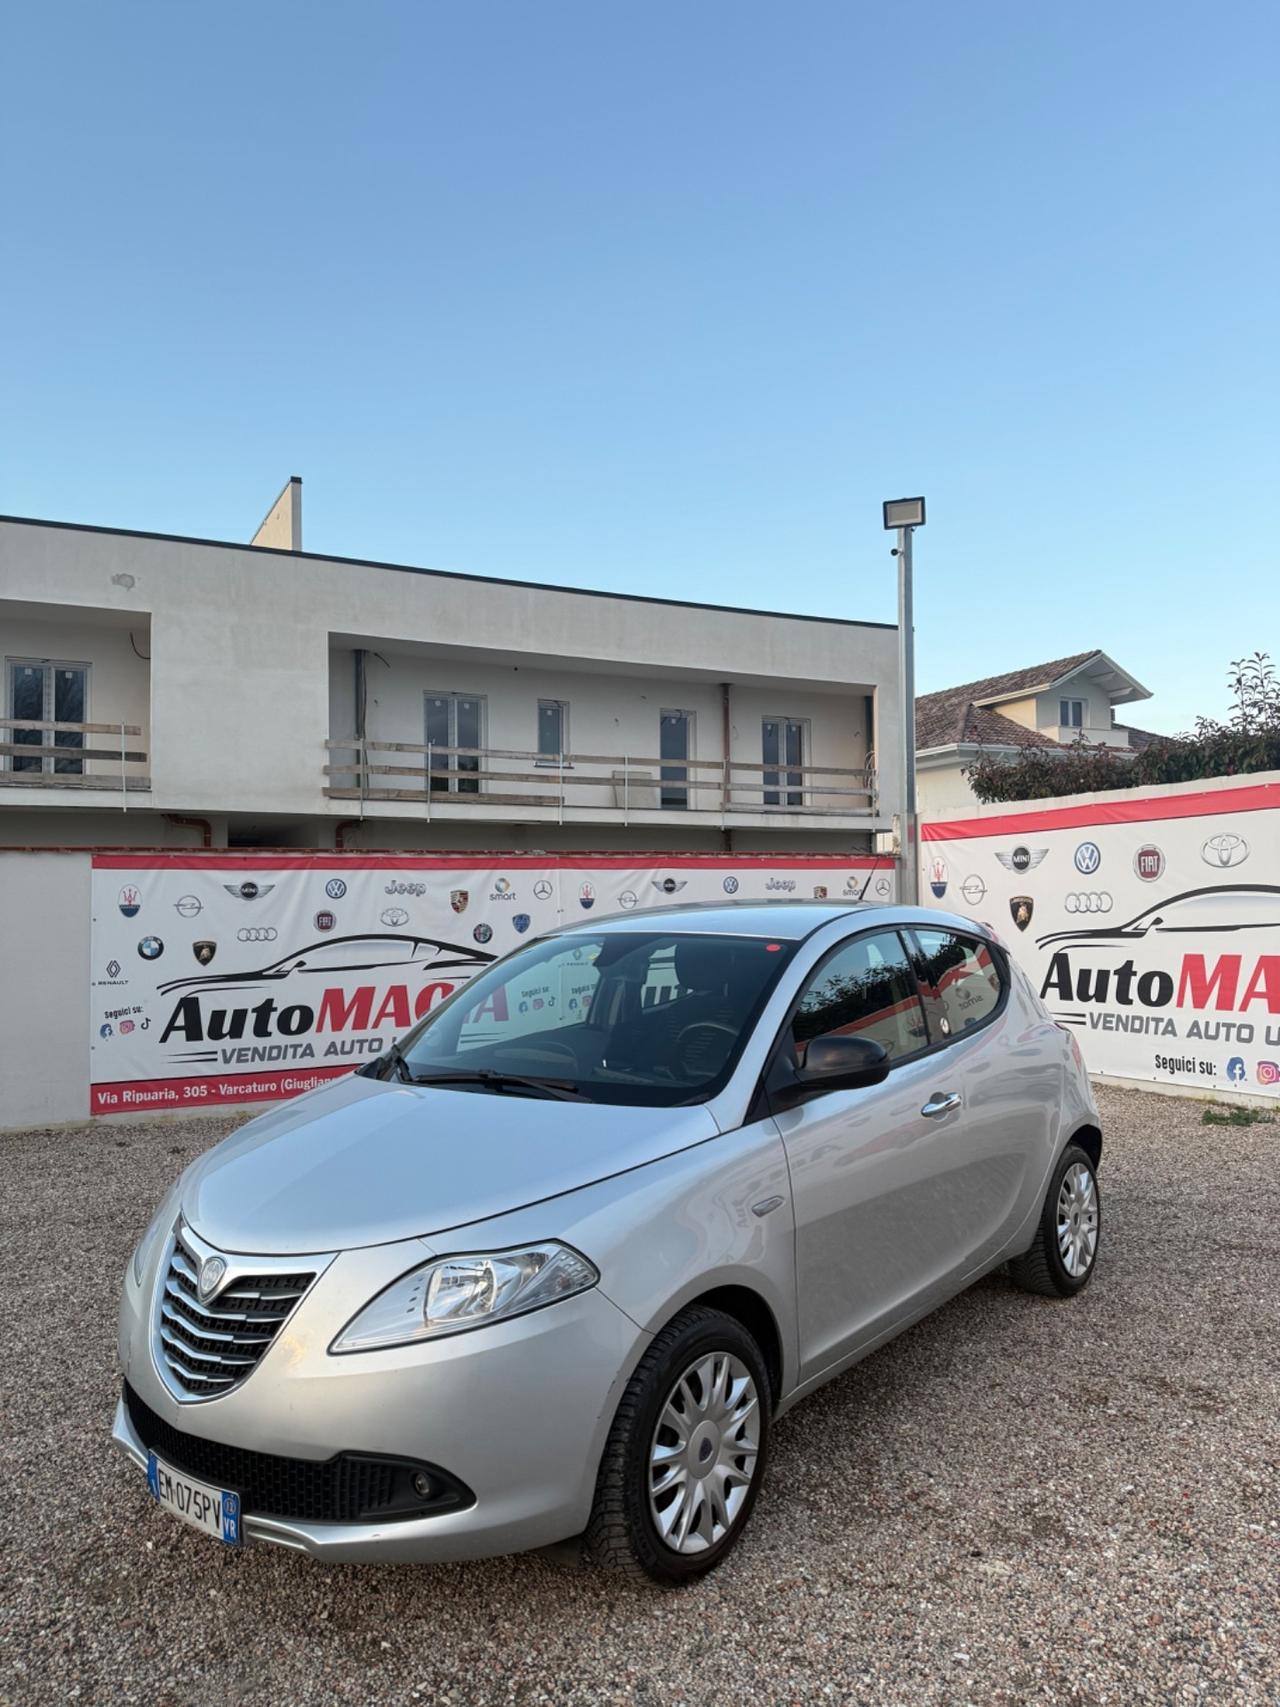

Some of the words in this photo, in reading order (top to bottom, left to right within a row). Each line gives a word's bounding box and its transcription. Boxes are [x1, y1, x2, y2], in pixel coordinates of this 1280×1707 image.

[1013, 855, 1030, 863] MINI
[1140, 855, 1160, 873] FIAT
[384, 879, 427, 897] Jeep
[764, 877, 797, 892] Jeep
[842, 888, 865, 896] smar
[489, 892, 517, 901] smart
[104, 1007, 132, 1019] Seguici
[1088, 1013, 1177, 1038] VENDITA
[1186, 1020, 1254, 1044] AUTO
[221, 1043, 315, 1064] VENDITA
[324, 1037, 384, 1057] AUTO
[1155, 1054, 1197, 1075] Seguici
[1199, 1060, 1217, 1076] su:
[97, 1092, 118, 1104] Via
[123, 1088, 179, 1105] Ripuaria,
[183, 1085, 208, 1098] 305
[219, 1081, 277, 1096] Varcaturo
[281, 1076, 337, 1095] (Giuglia
[223, 1517, 236, 1539] VR
